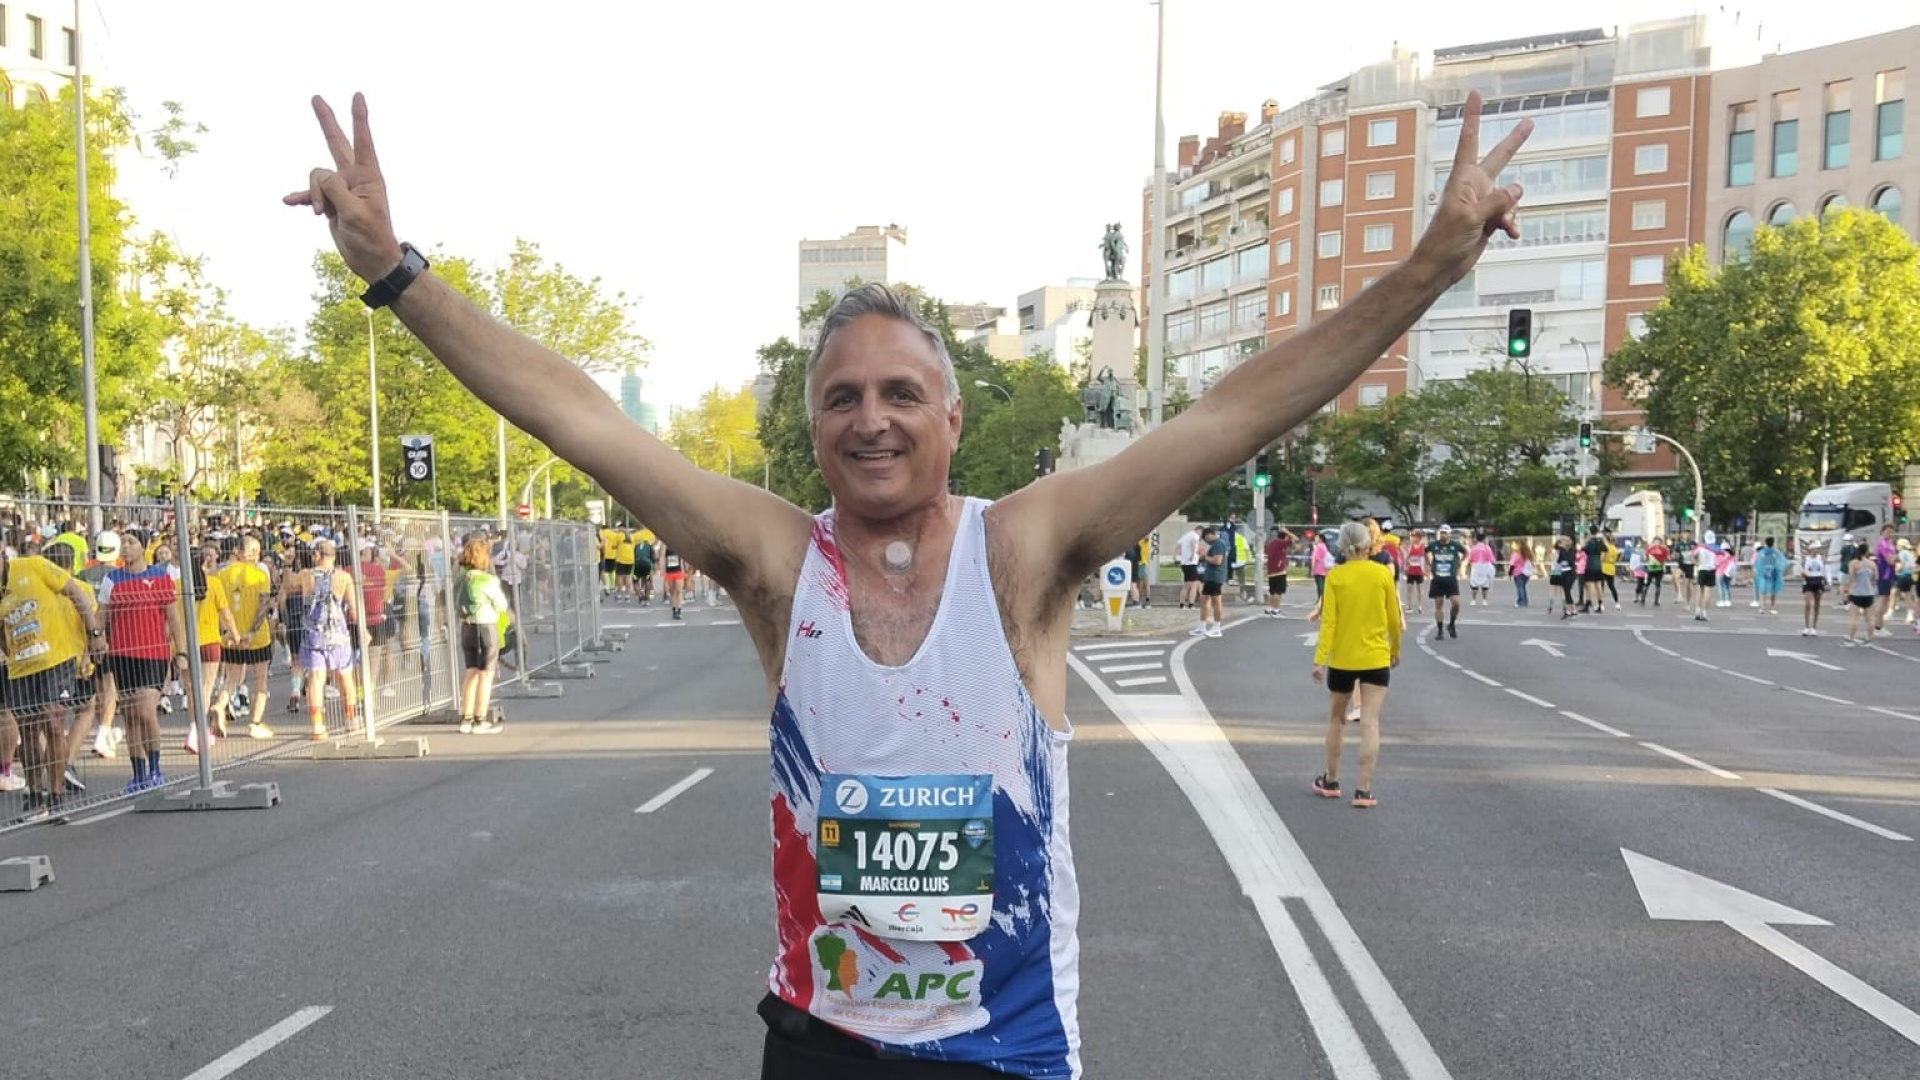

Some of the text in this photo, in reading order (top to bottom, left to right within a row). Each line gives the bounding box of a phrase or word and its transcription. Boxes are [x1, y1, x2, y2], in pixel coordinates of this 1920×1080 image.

[879, 786, 975, 807] ZURICH
[824, 827, 836, 839] 11
[853, 830, 960, 871] 14075
[860, 875, 950, 892] MARCELO LUIS
[874, 969, 975, 1000] APC
